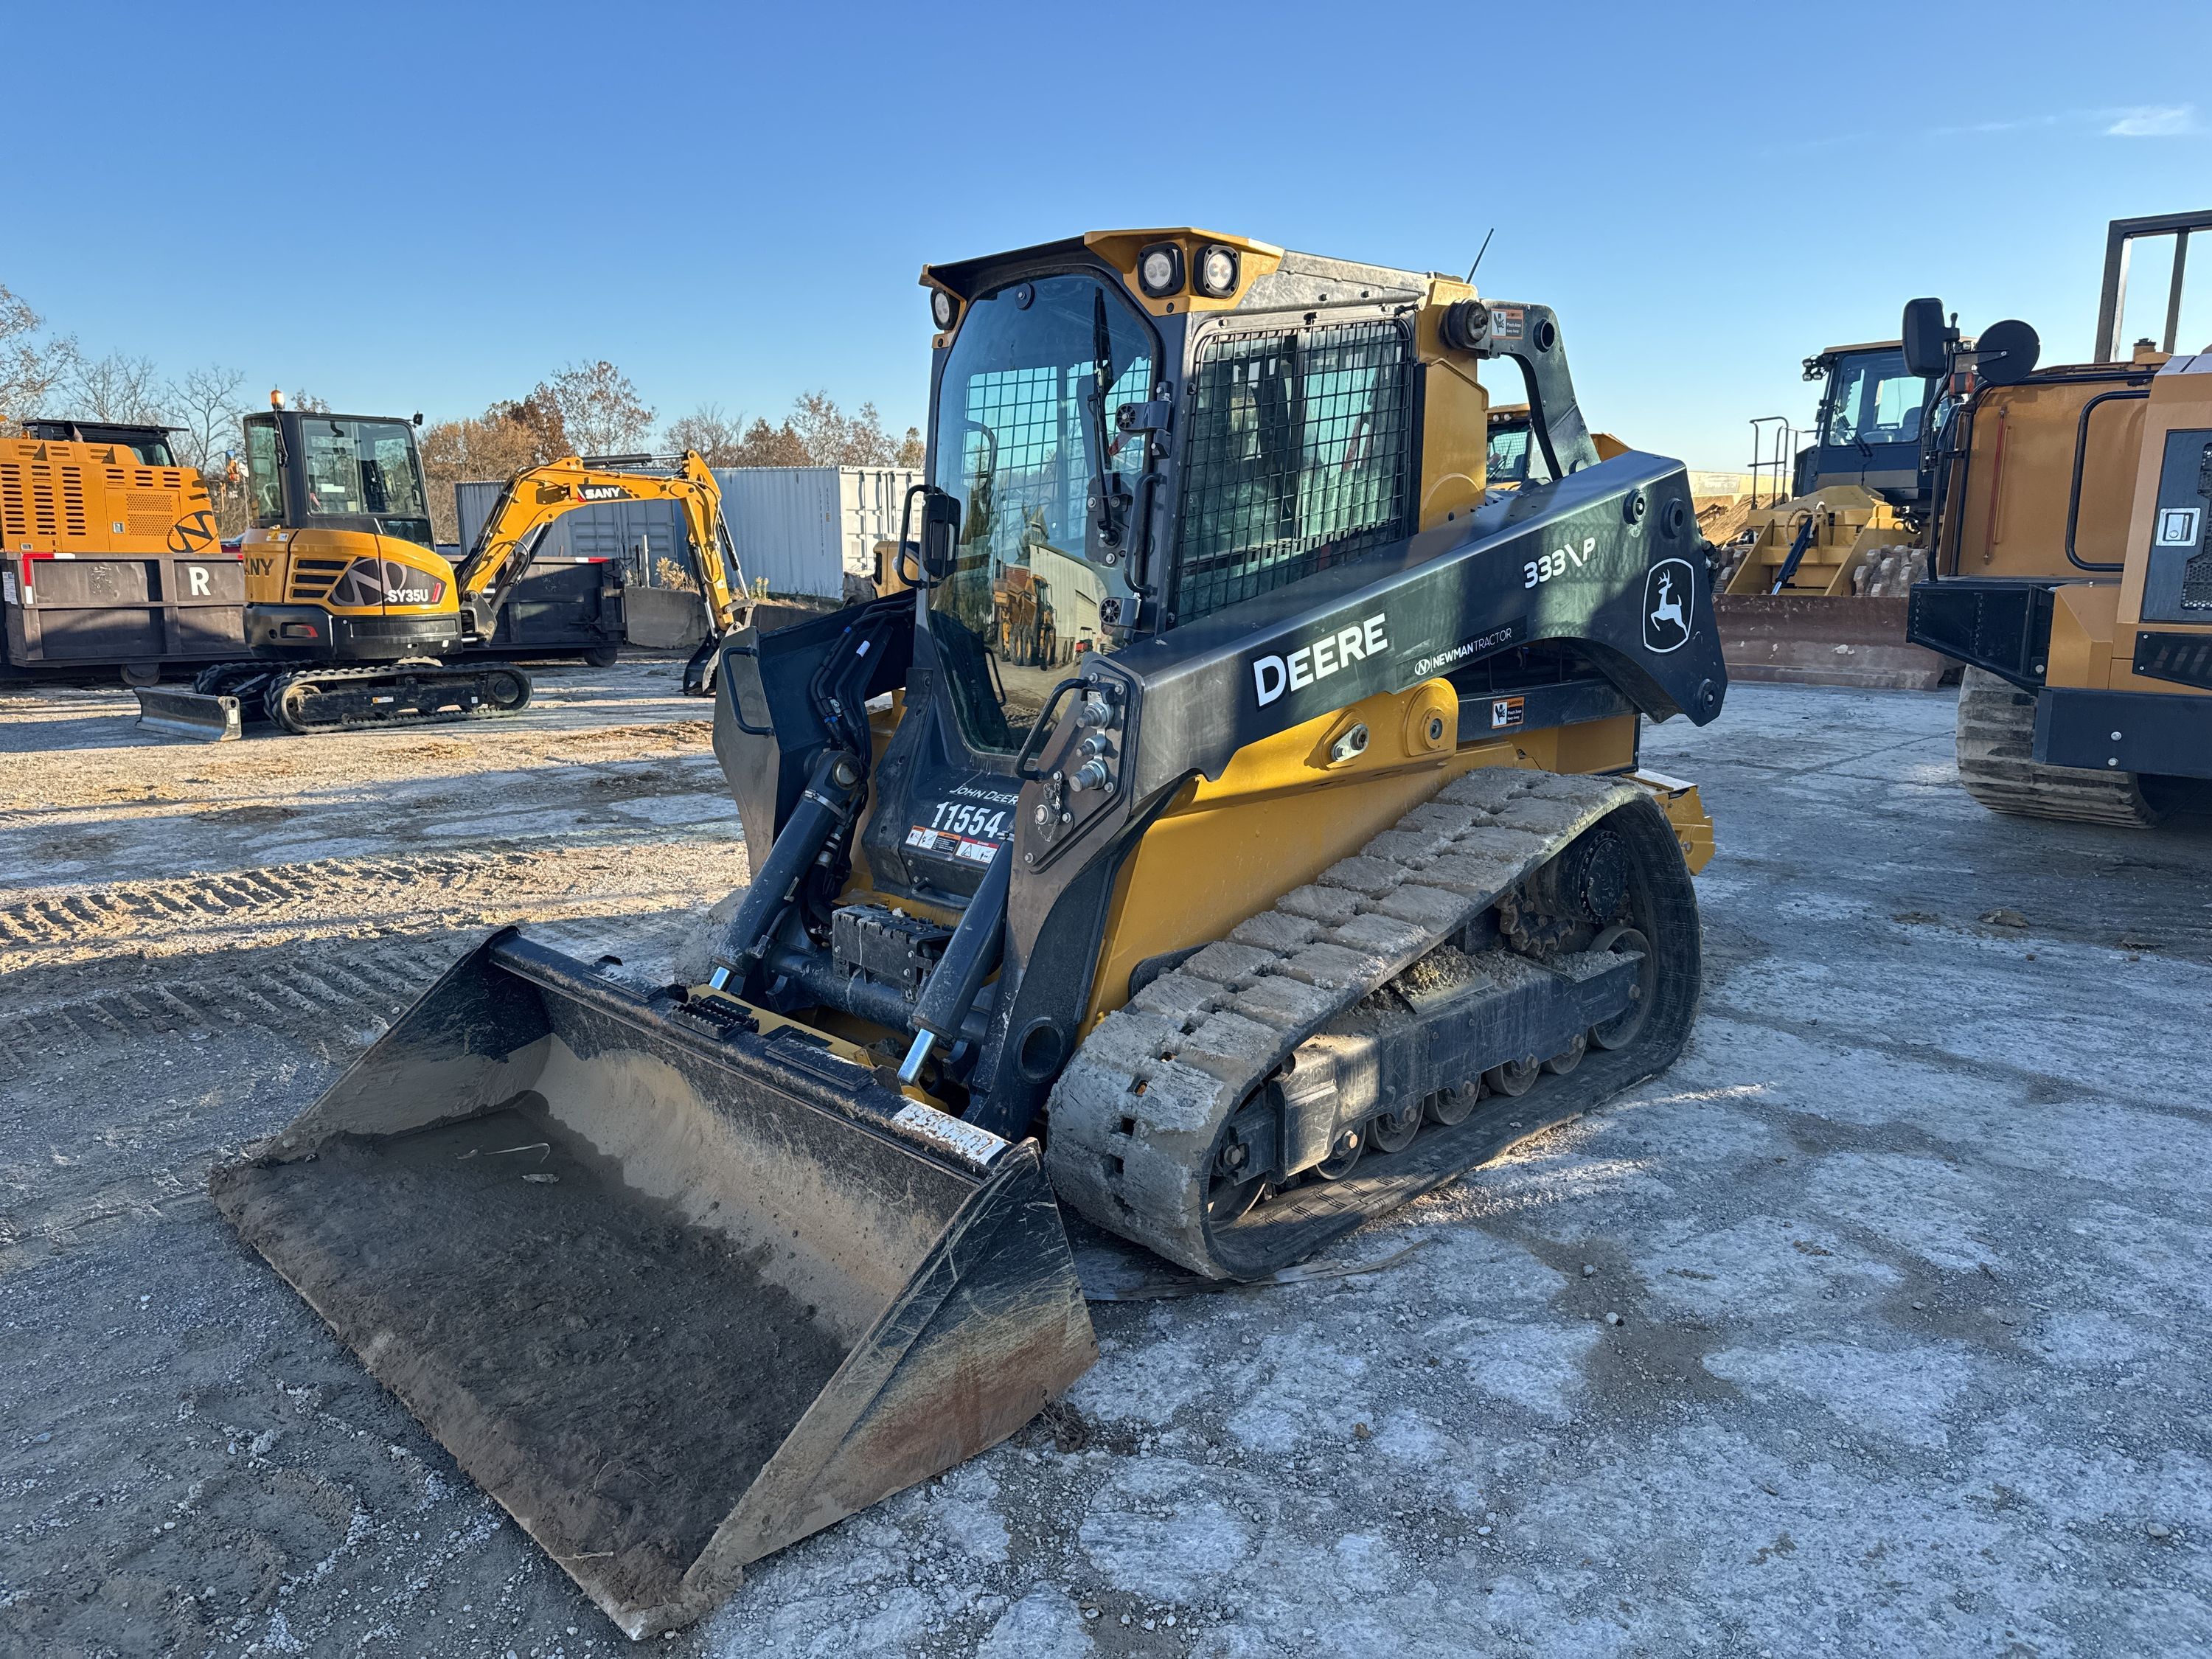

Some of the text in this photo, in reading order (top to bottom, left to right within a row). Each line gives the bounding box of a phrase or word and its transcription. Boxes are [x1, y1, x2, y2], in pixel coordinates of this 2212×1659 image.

[585, 487, 620, 499] SANY
[189, 566, 211, 596] R
[388, 588, 429, 603] SY35U
[1253, 613, 1388, 706] DEERE
[949, 785, 1019, 804] JOHN DEER
[931, 801, 1006, 838] 11554
